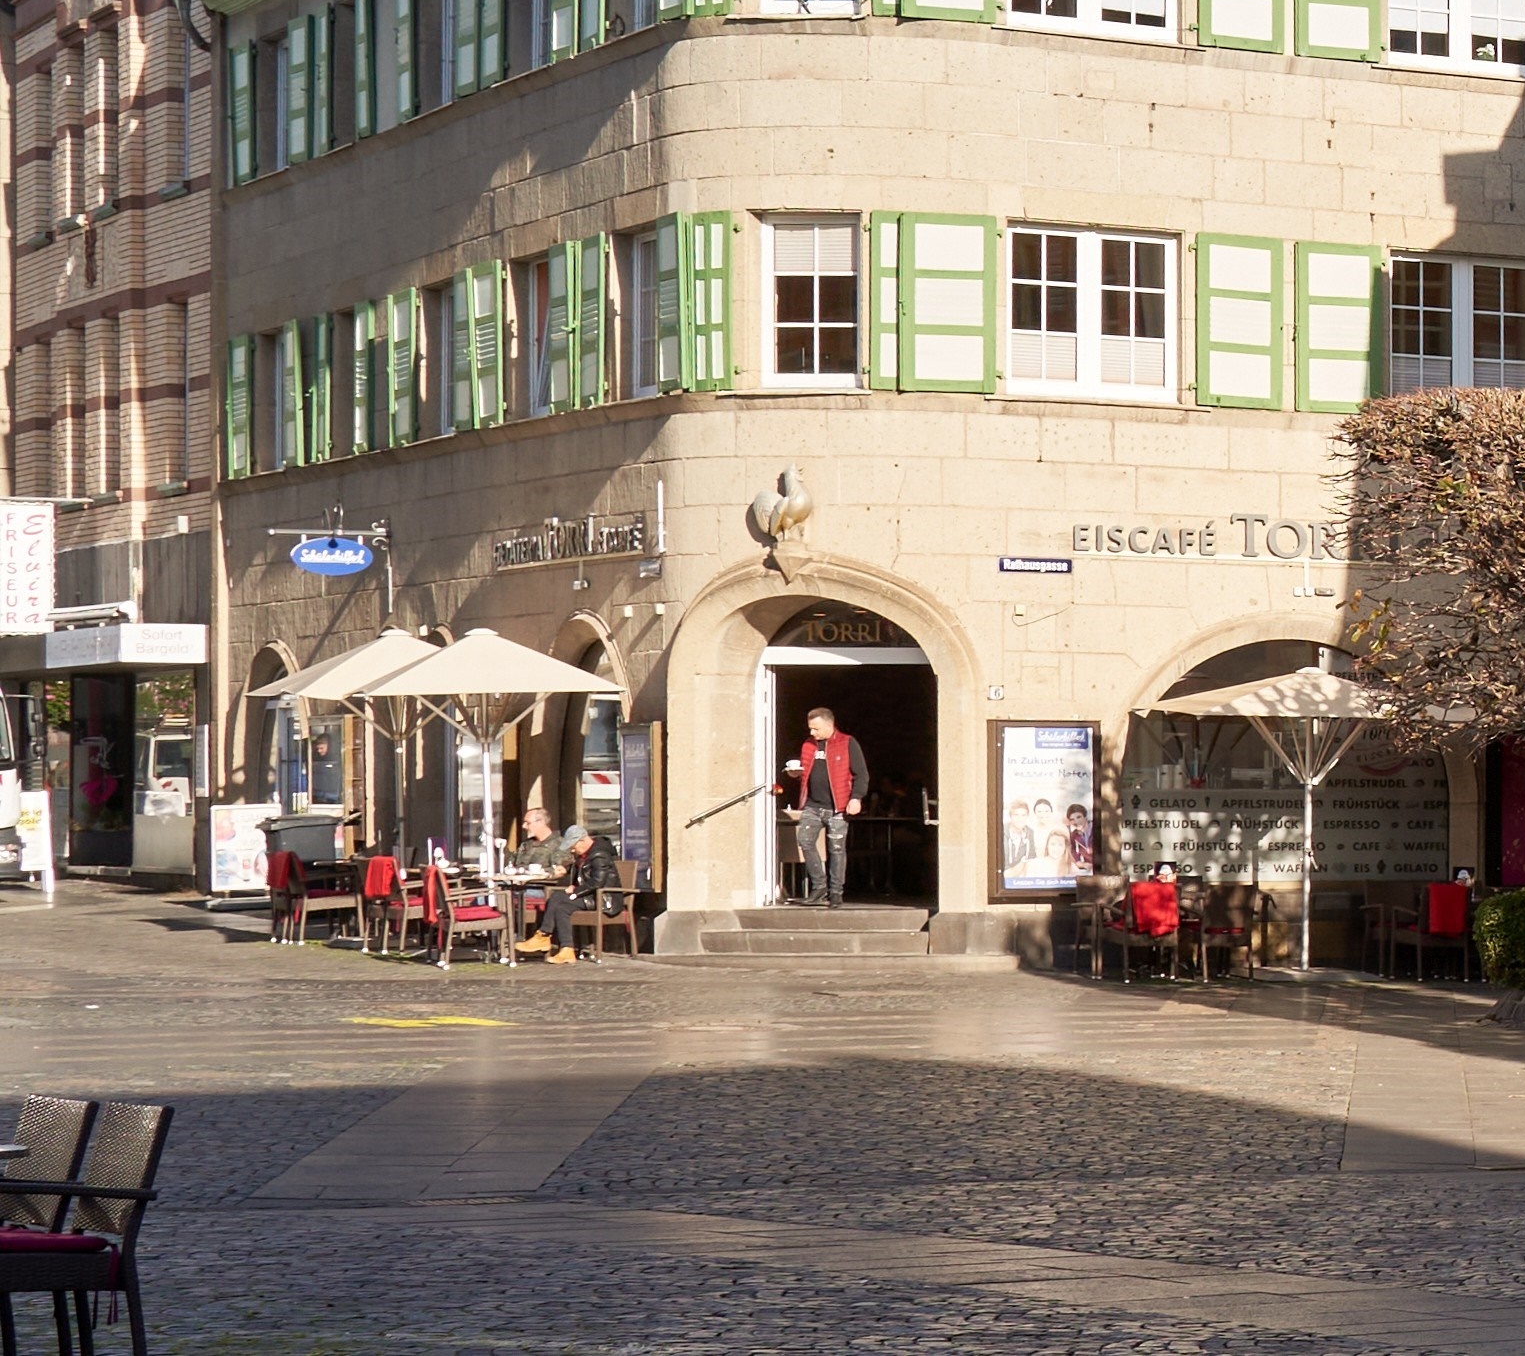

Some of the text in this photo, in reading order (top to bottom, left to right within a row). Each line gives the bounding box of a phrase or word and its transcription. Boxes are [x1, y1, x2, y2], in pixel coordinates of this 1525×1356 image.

[1072, 519, 1217, 557] EISCAFÉ
[1230, 513, 1385, 561] TOR
[6, 512, 18, 624] FRISEUR
[1003, 558, 1068, 573] Rathausgasse
[142, 629, 182, 640] Sofort
[801, 619, 882, 643] TORRI
[994, 689, 1001, 698] 6
[1007, 757, 1064, 765] In Zukunft
[1058, 769, 1089, 778] Noten
[1326, 778, 1407, 788] APFELSTRUDEL
[1150, 798, 1197, 809] GELATO
[1221, 798, 1305, 809] APFELSTRUDEL
[1333, 797, 1400, 810] FRÜHSTÜCK
[1230, 817, 1299, 829] FRÜHSTÜCK
[1323, 820, 1381, 830] ESPRESSO
[1173, 839, 1243, 852] FRÜHSTÜCK
[1133, 864, 1193, 873] ESPSO
[1354, 864, 1370, 873] EIS
[1394, 864, 1438, 873] GELATO
